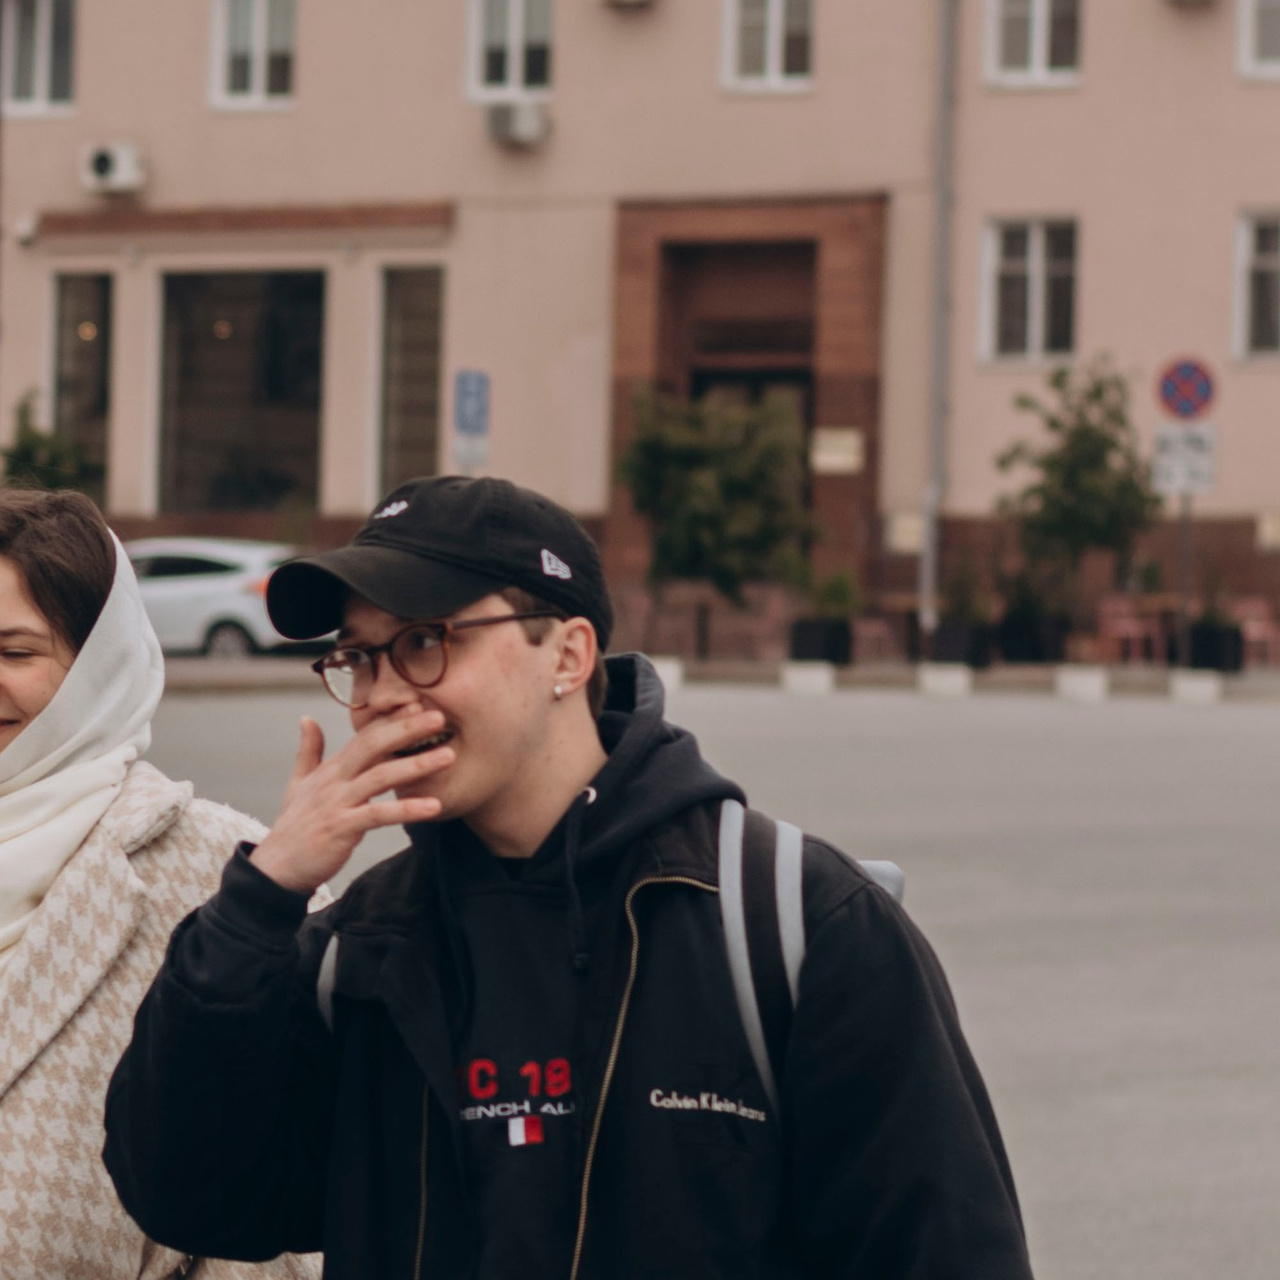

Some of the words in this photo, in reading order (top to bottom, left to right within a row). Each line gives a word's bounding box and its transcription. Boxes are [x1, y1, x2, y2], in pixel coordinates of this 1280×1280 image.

[460, 1058, 499, 1099] C
[460, 1100, 531, 1121] ENCH
[540, 1101, 575, 1117] AL
[650, 1088, 699, 1109] Calvin
[700, 1091, 737, 1113] Klein
